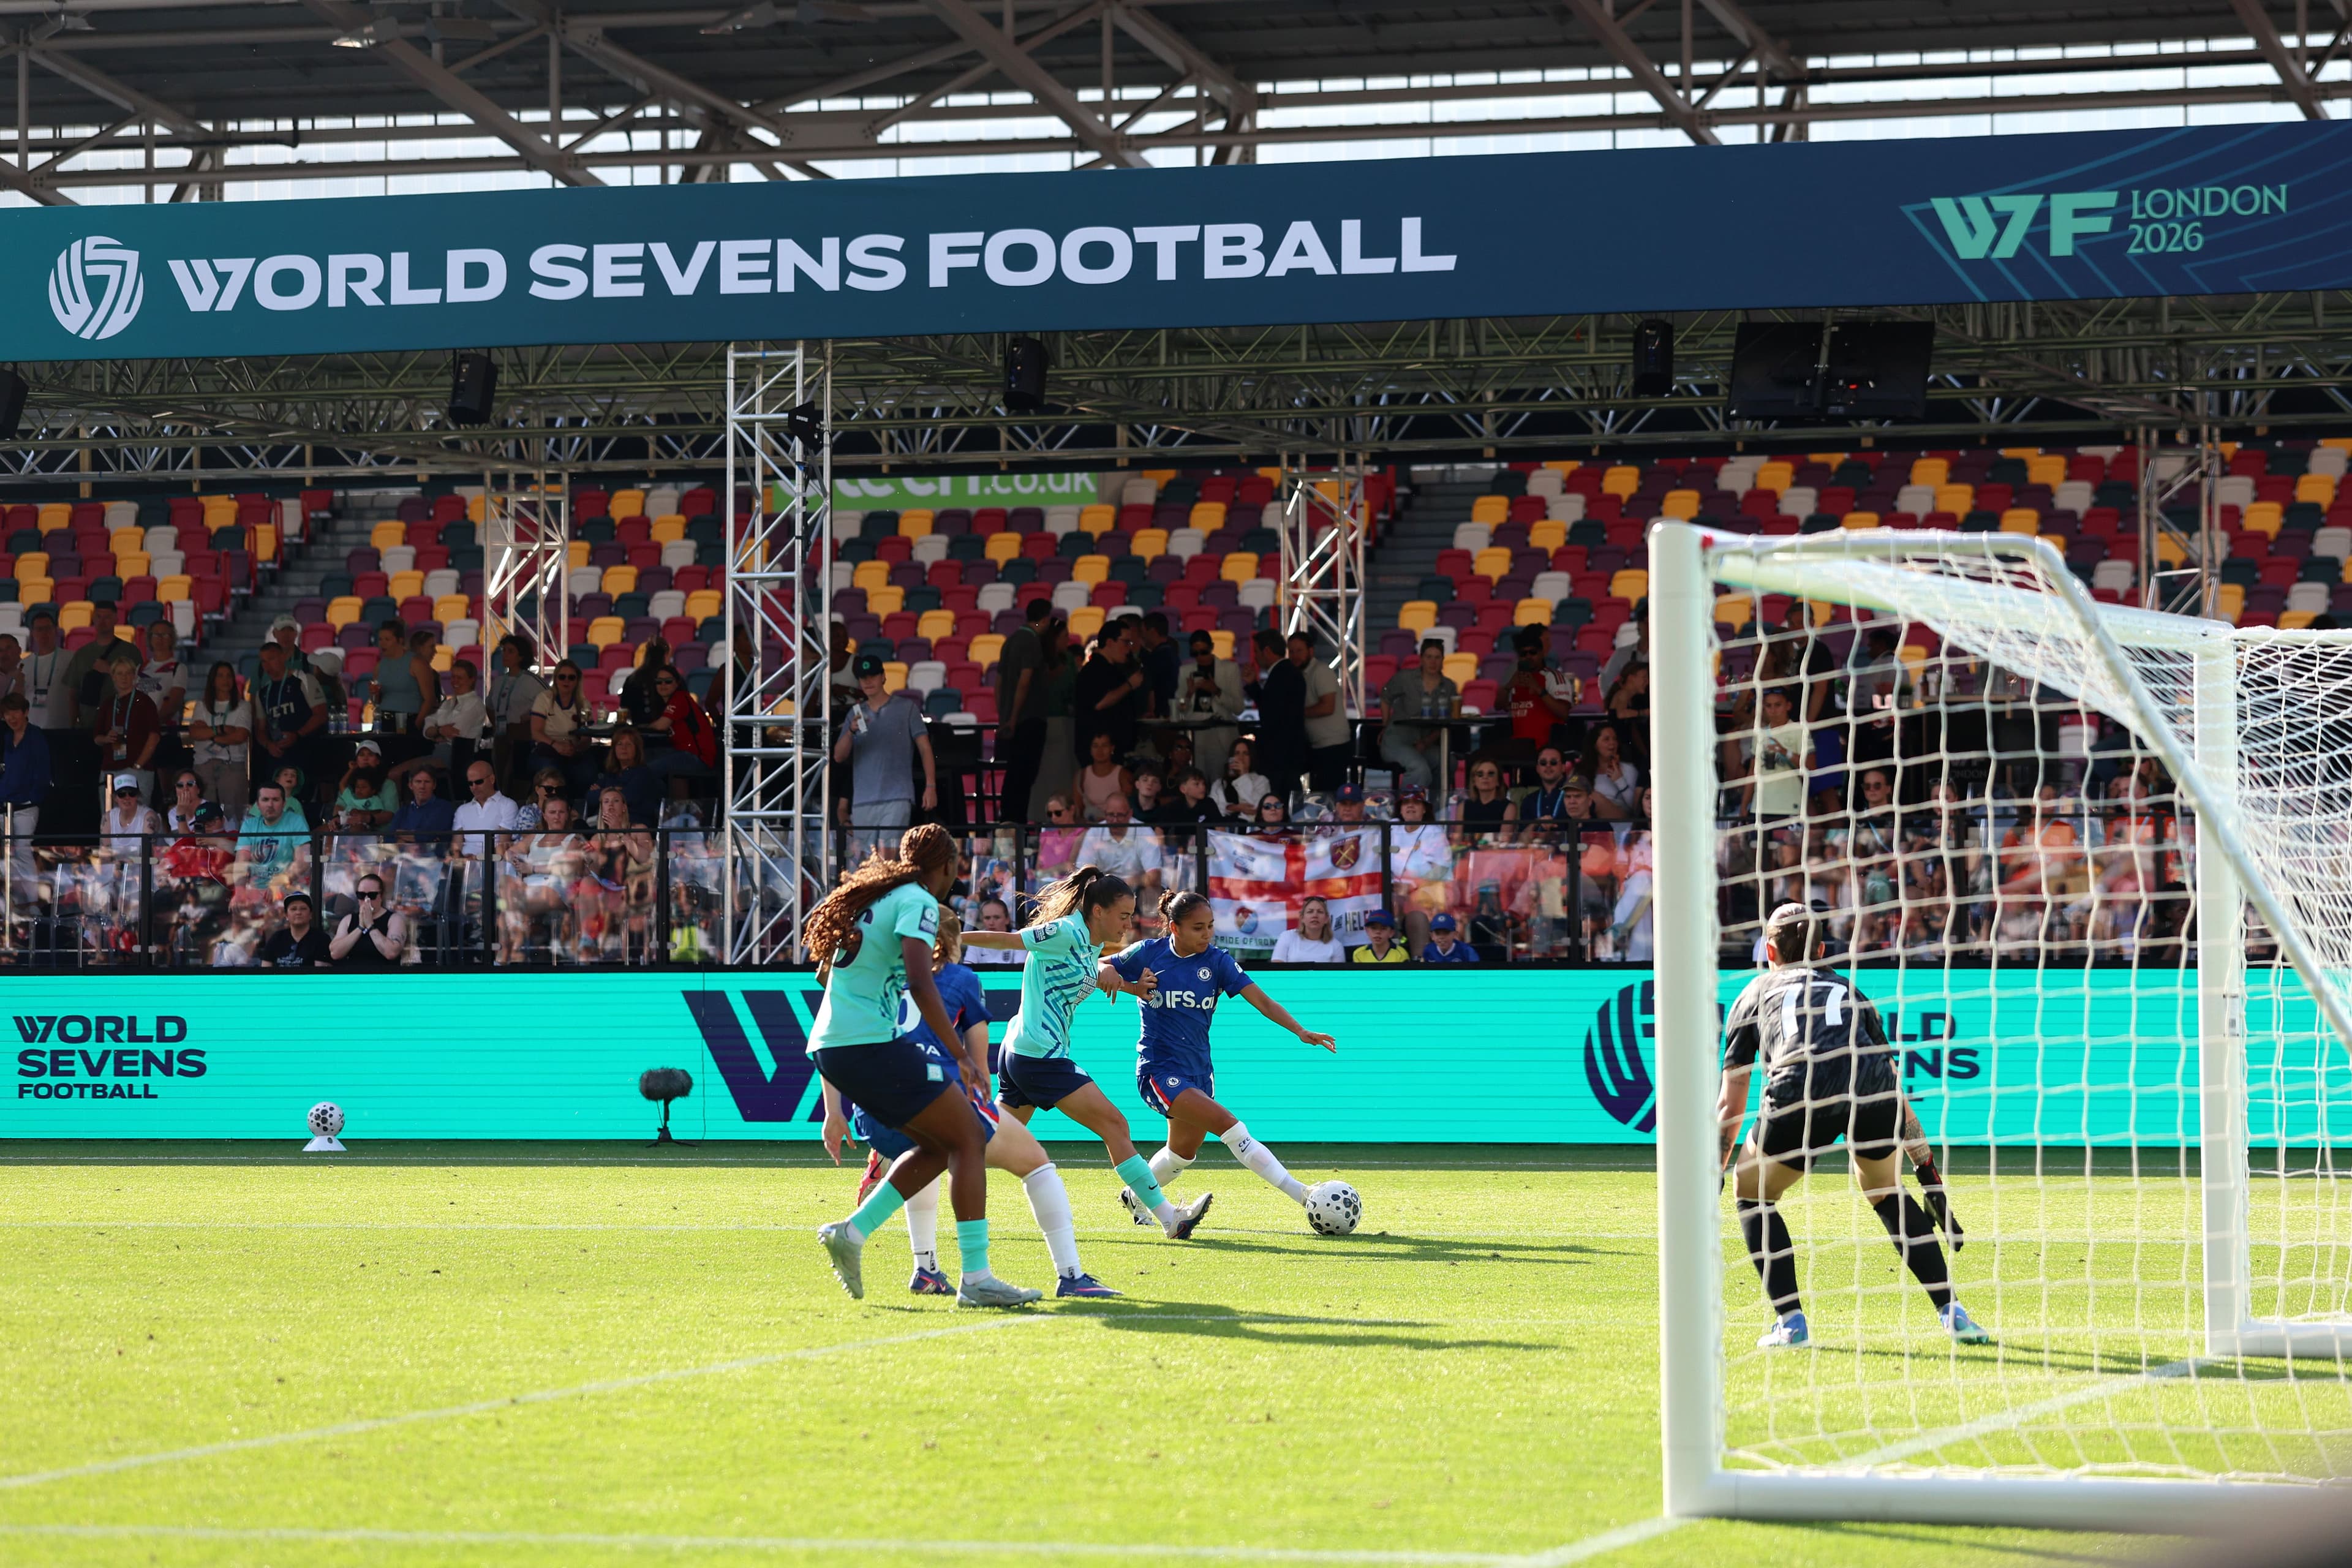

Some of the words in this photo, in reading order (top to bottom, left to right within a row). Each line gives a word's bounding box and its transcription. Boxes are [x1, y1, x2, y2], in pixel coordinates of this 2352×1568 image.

[2131, 184, 2288, 219] LONDON
[2127, 222, 2204, 254] 2026
[167, 249, 507, 312] WORLD
[529, 234, 906, 300] SEVENS
[929, 217, 1457, 288] FOOTBALL
[1215, 935, 1240, 944] PRIDE
[1165, 989, 1214, 1010] IFS.ai
[1763, 981, 1848, 1039] 77
[12, 1015, 187, 1044] WORLD
[17, 1049, 207, 1078] SEVENS
[17, 1082, 158, 1099] FOOTBALL
[1238, 1137, 1250, 1147] CFC
